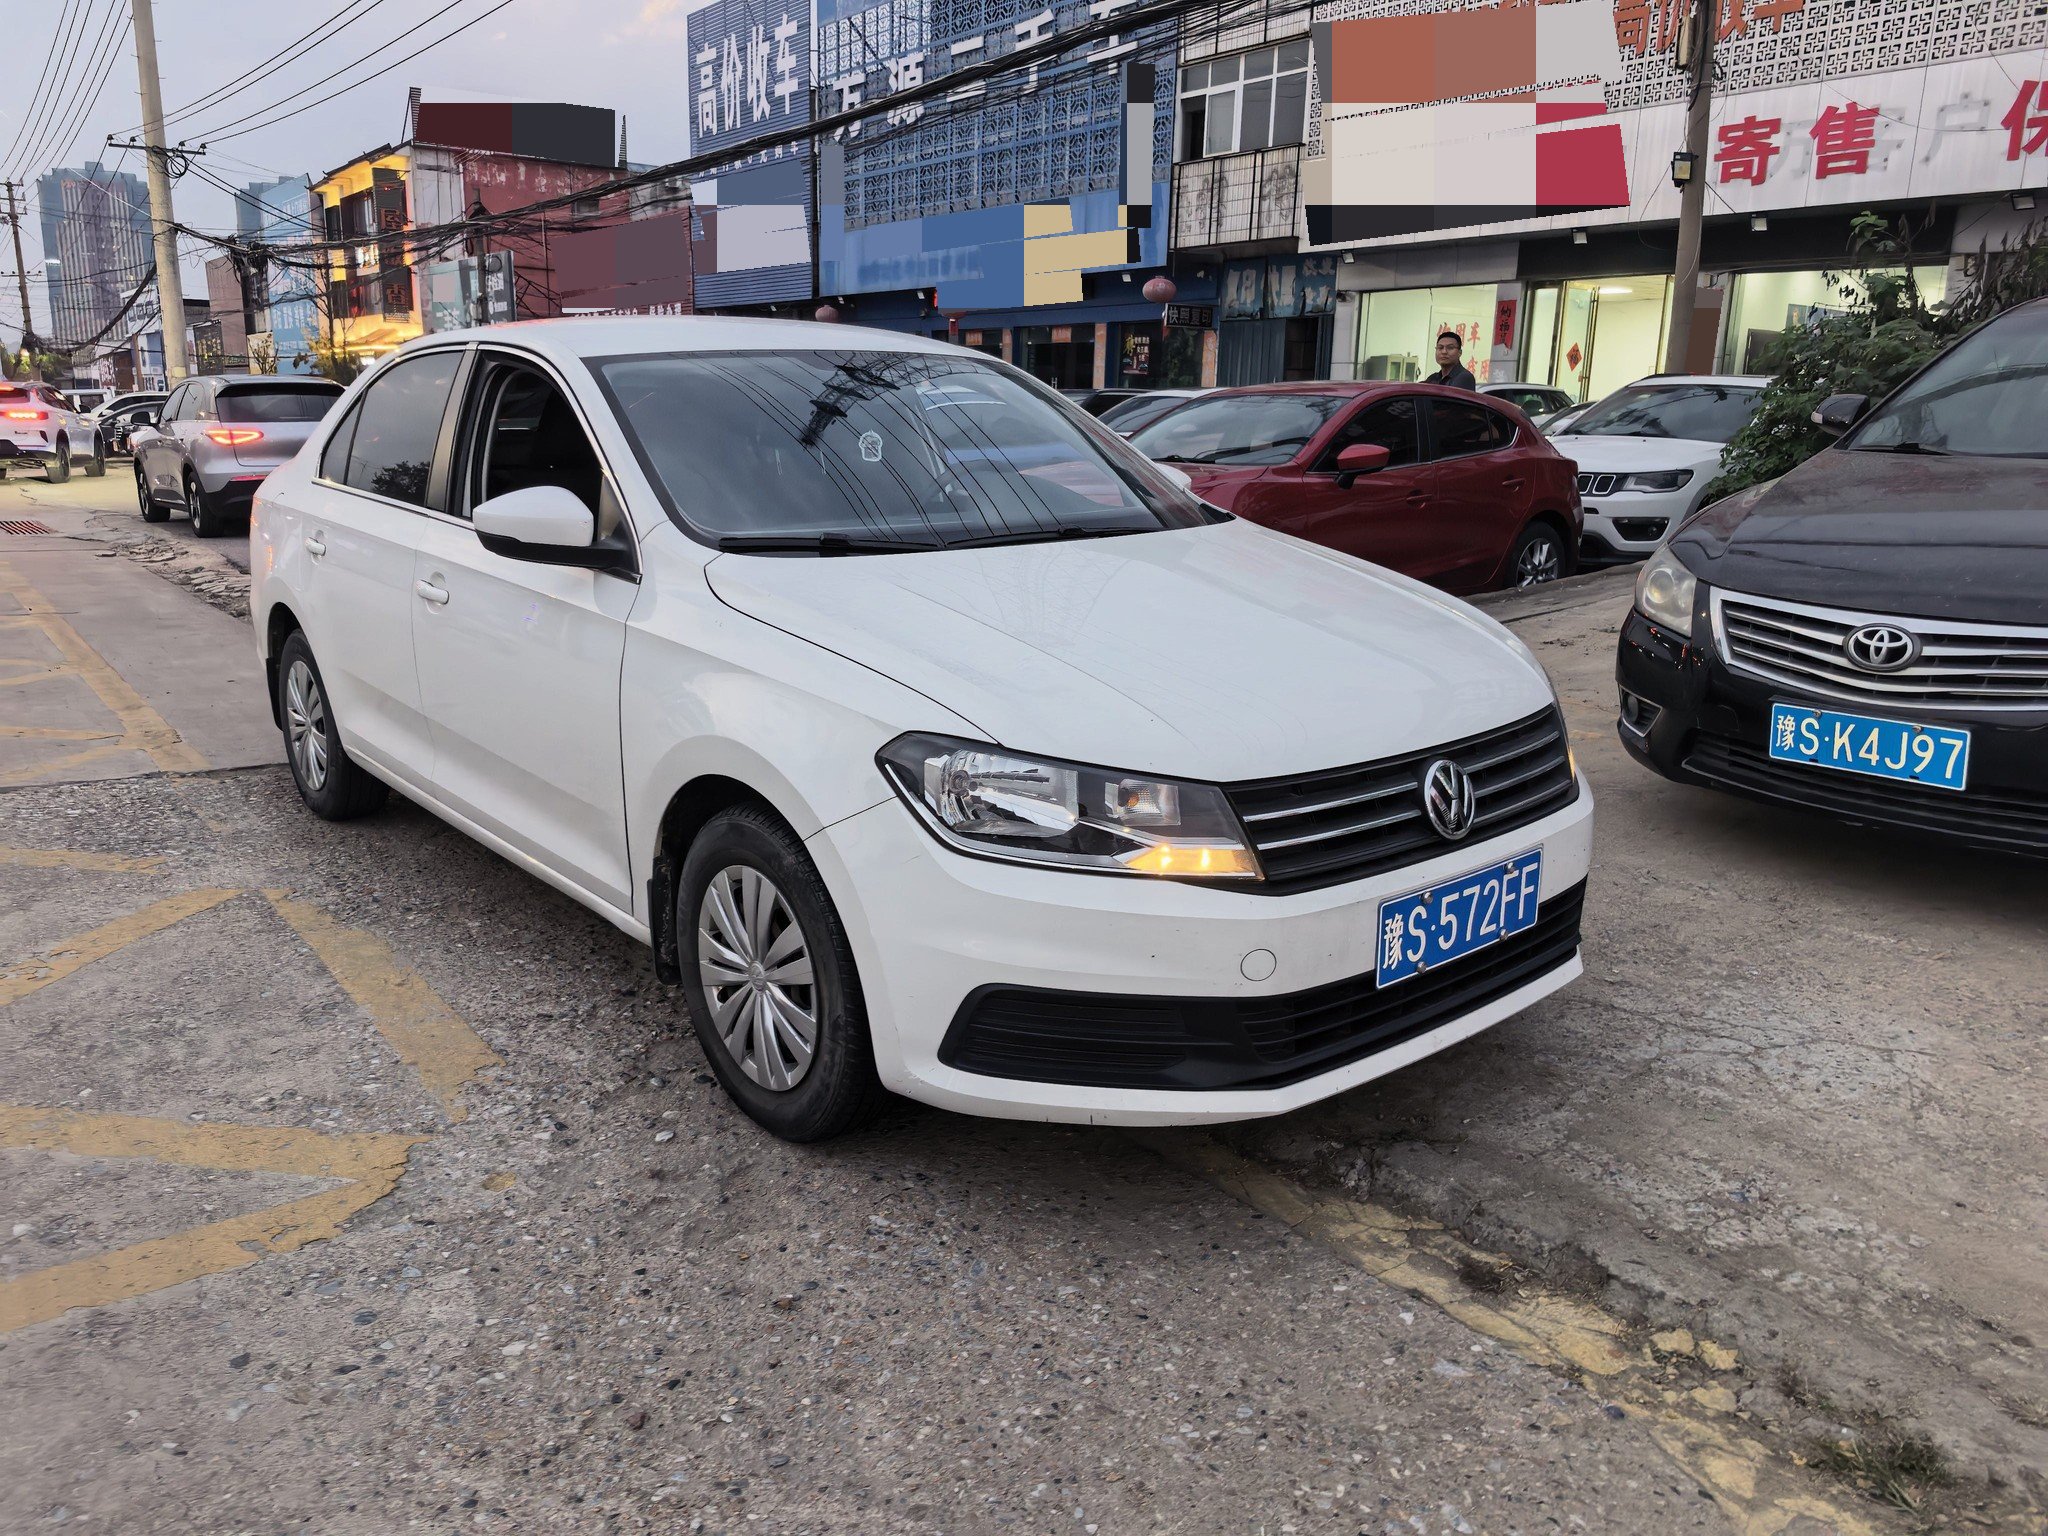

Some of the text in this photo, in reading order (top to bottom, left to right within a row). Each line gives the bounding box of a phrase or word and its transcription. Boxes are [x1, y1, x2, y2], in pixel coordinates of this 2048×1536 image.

[696, 13, 798, 138] 高价收车
[1714, 102, 1880, 187] 寄售
[1776, 714, 1964, 780] 豫S·K4J97
[1382, 862, 1538, 970] 豫S·572FF
